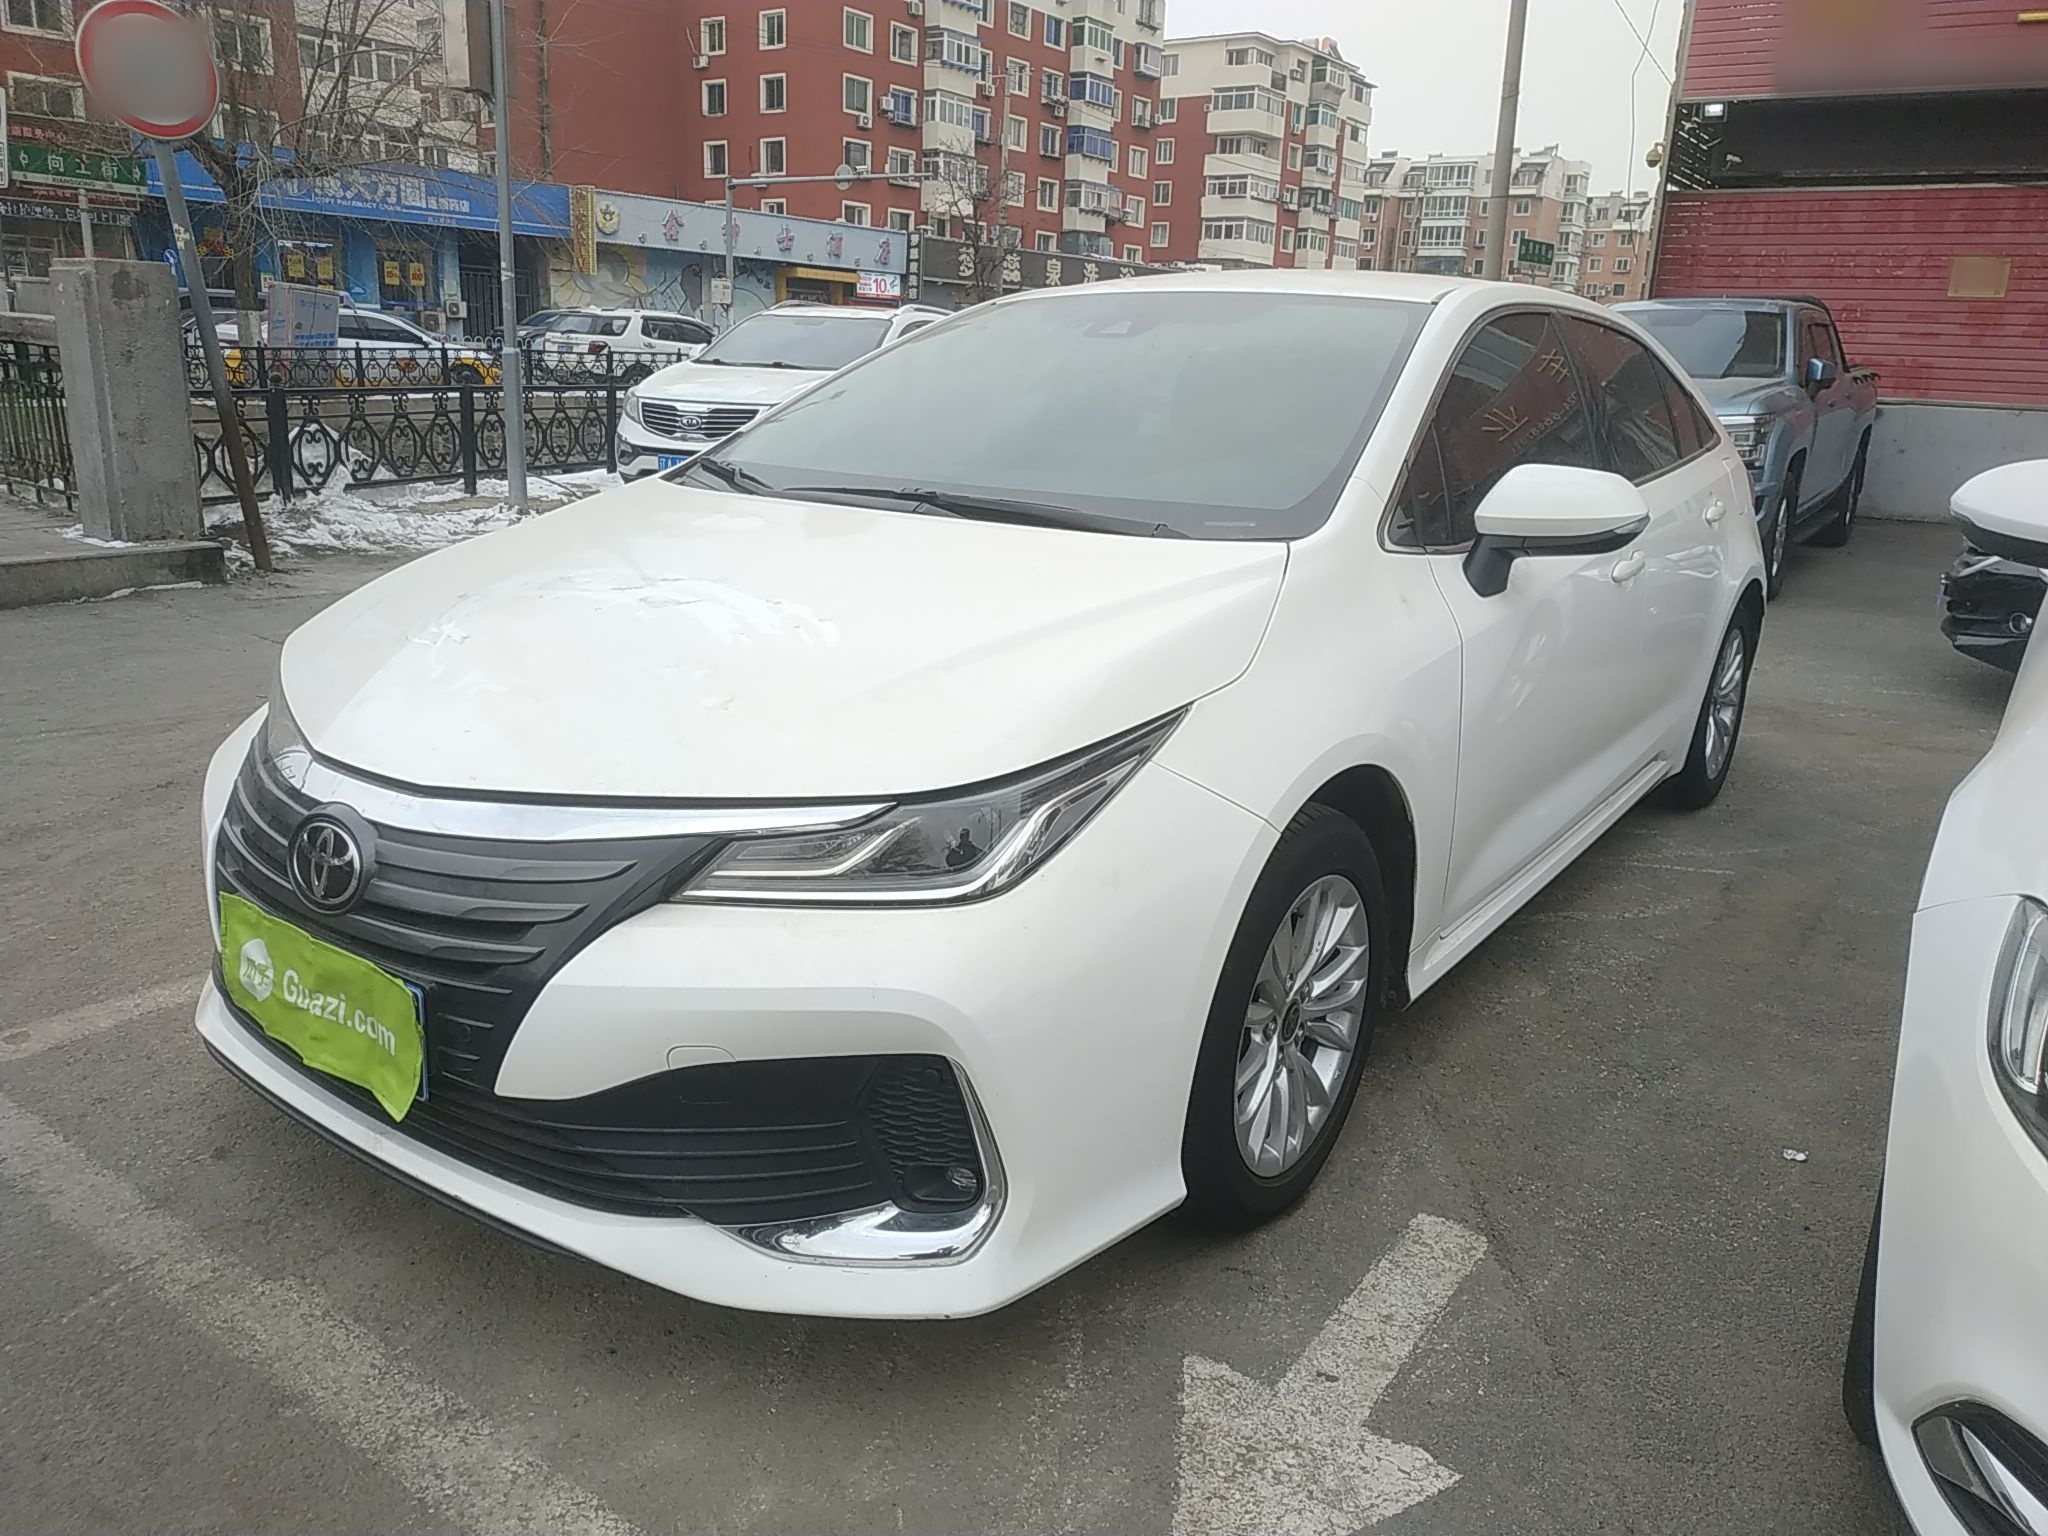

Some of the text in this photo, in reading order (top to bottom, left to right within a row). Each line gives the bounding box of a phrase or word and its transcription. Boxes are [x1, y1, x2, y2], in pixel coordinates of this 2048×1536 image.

[48, 152, 119, 178] 向工街
[873, 277, 887, 293] 10
[283, 969, 396, 1057] Guazi.com
